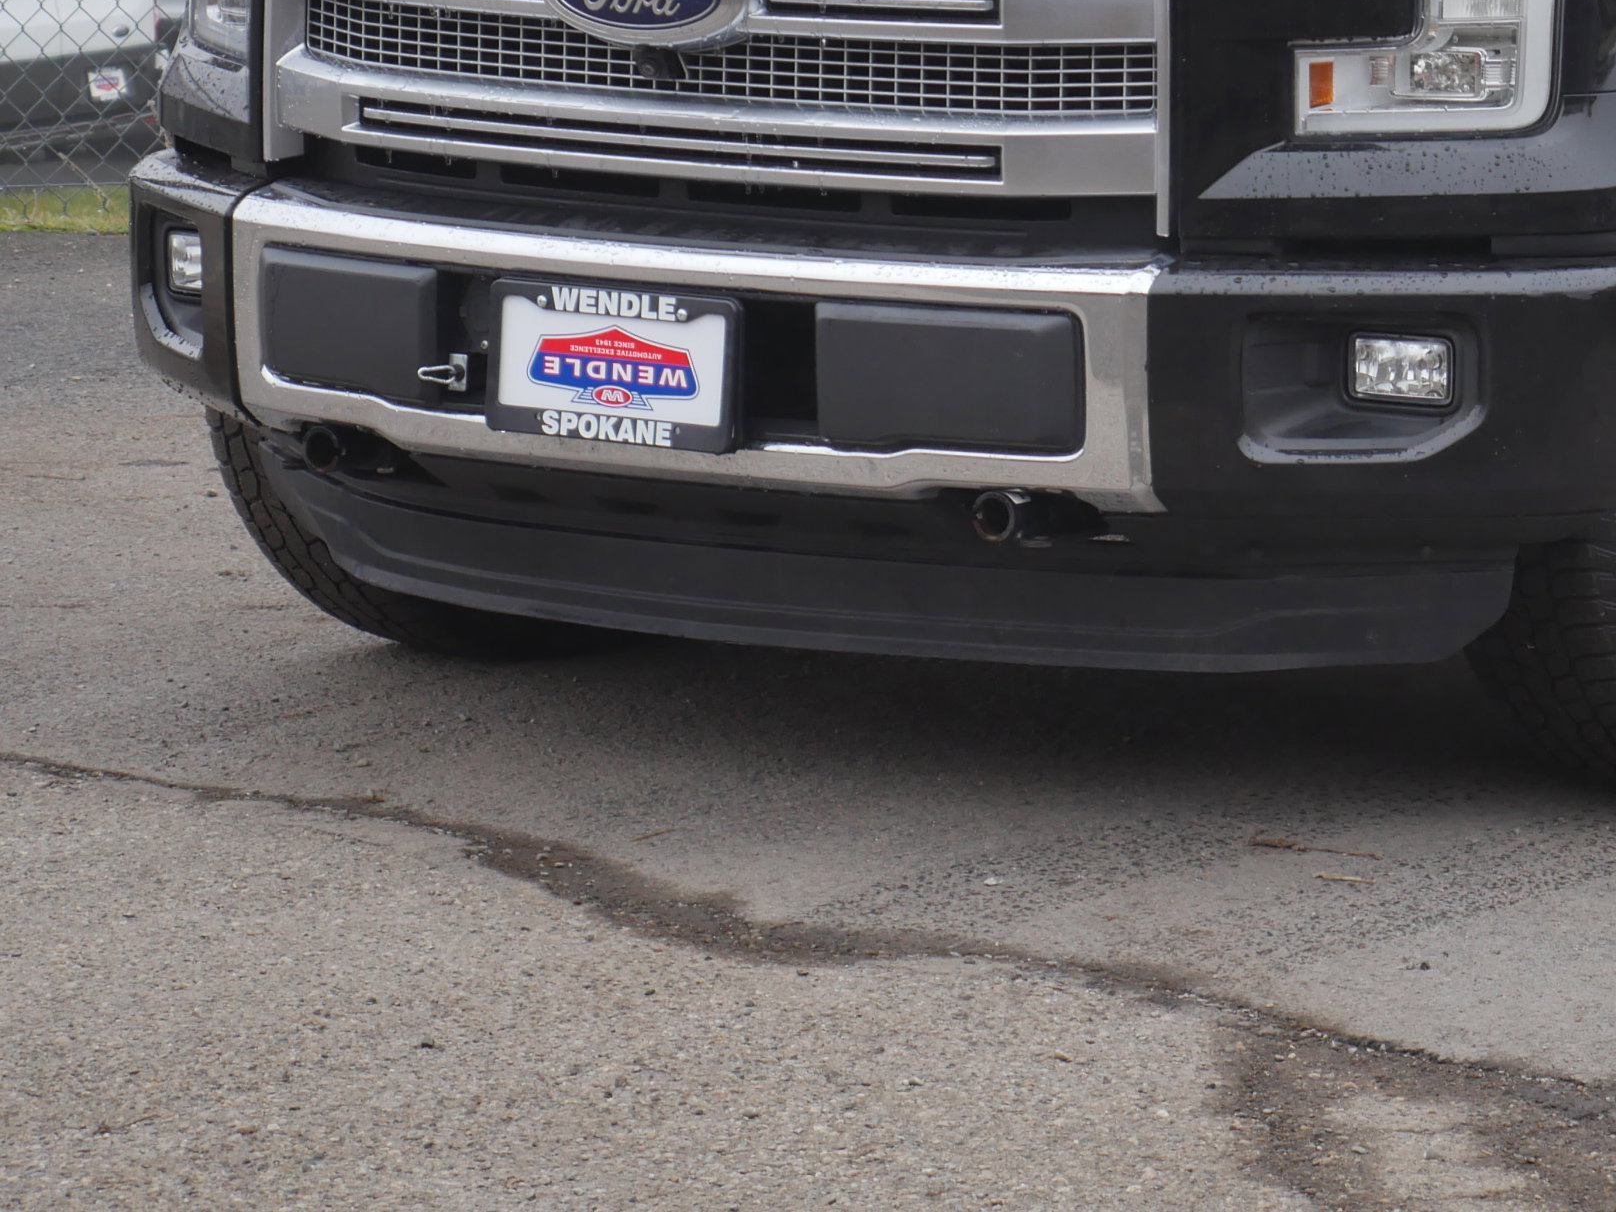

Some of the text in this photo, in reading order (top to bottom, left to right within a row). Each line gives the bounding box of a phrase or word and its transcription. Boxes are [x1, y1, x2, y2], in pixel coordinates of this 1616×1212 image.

[551, 286, 677, 322] WENDLE
[569, 344, 662, 360] AUTOMOTIVE EXCELLENCE
[595, 338, 635, 349] SINCE 1943
[543, 355, 689, 389] WENDLE
[541, 409, 672, 447] SPOKANE
